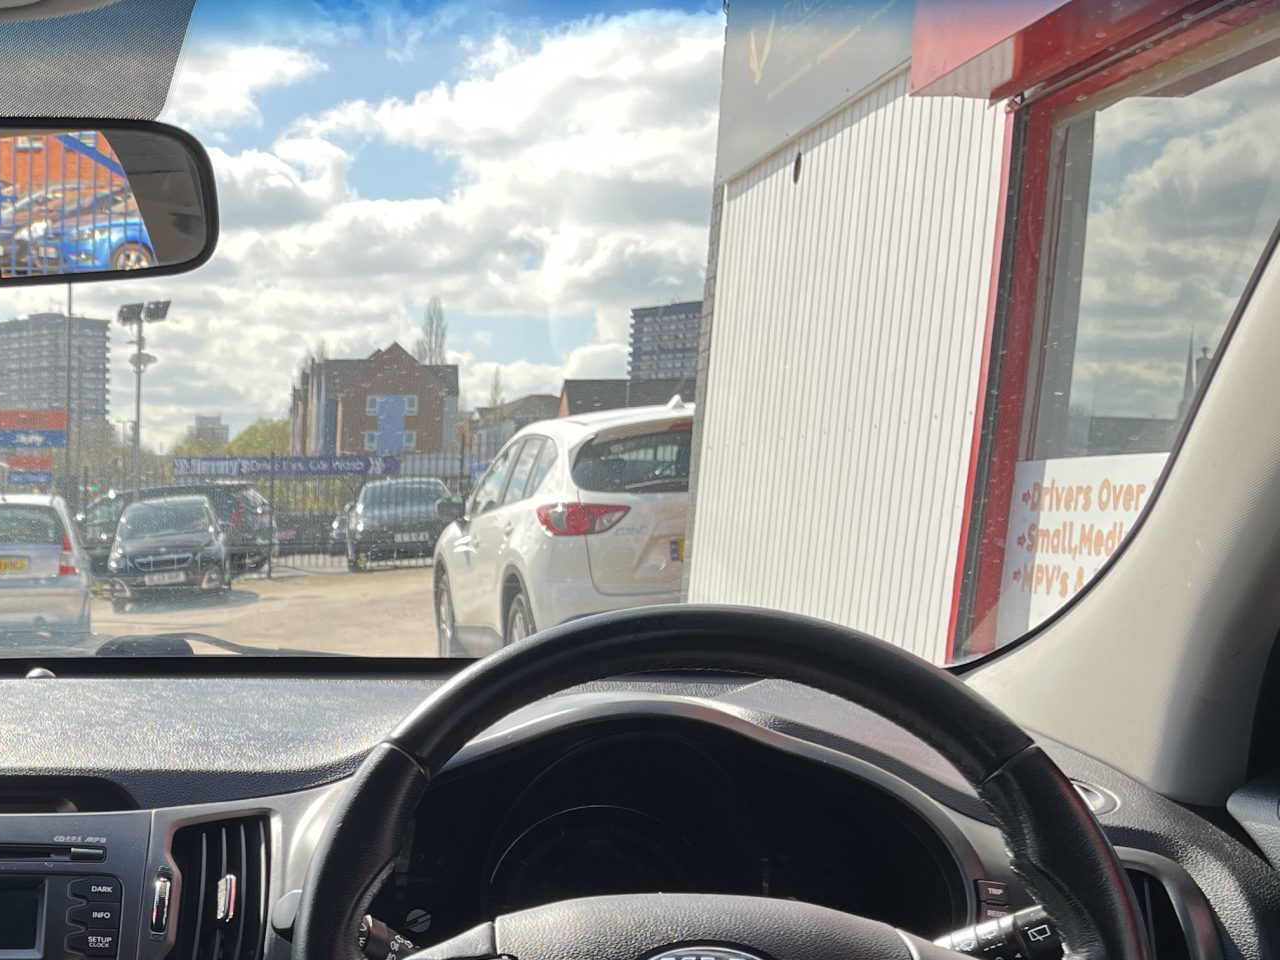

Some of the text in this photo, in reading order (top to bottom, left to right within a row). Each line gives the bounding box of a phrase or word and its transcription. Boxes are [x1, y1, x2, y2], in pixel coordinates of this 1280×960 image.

[1030, 478, 1147, 512] Drivers Over
[1020, 564, 1069, 598] MPV's
